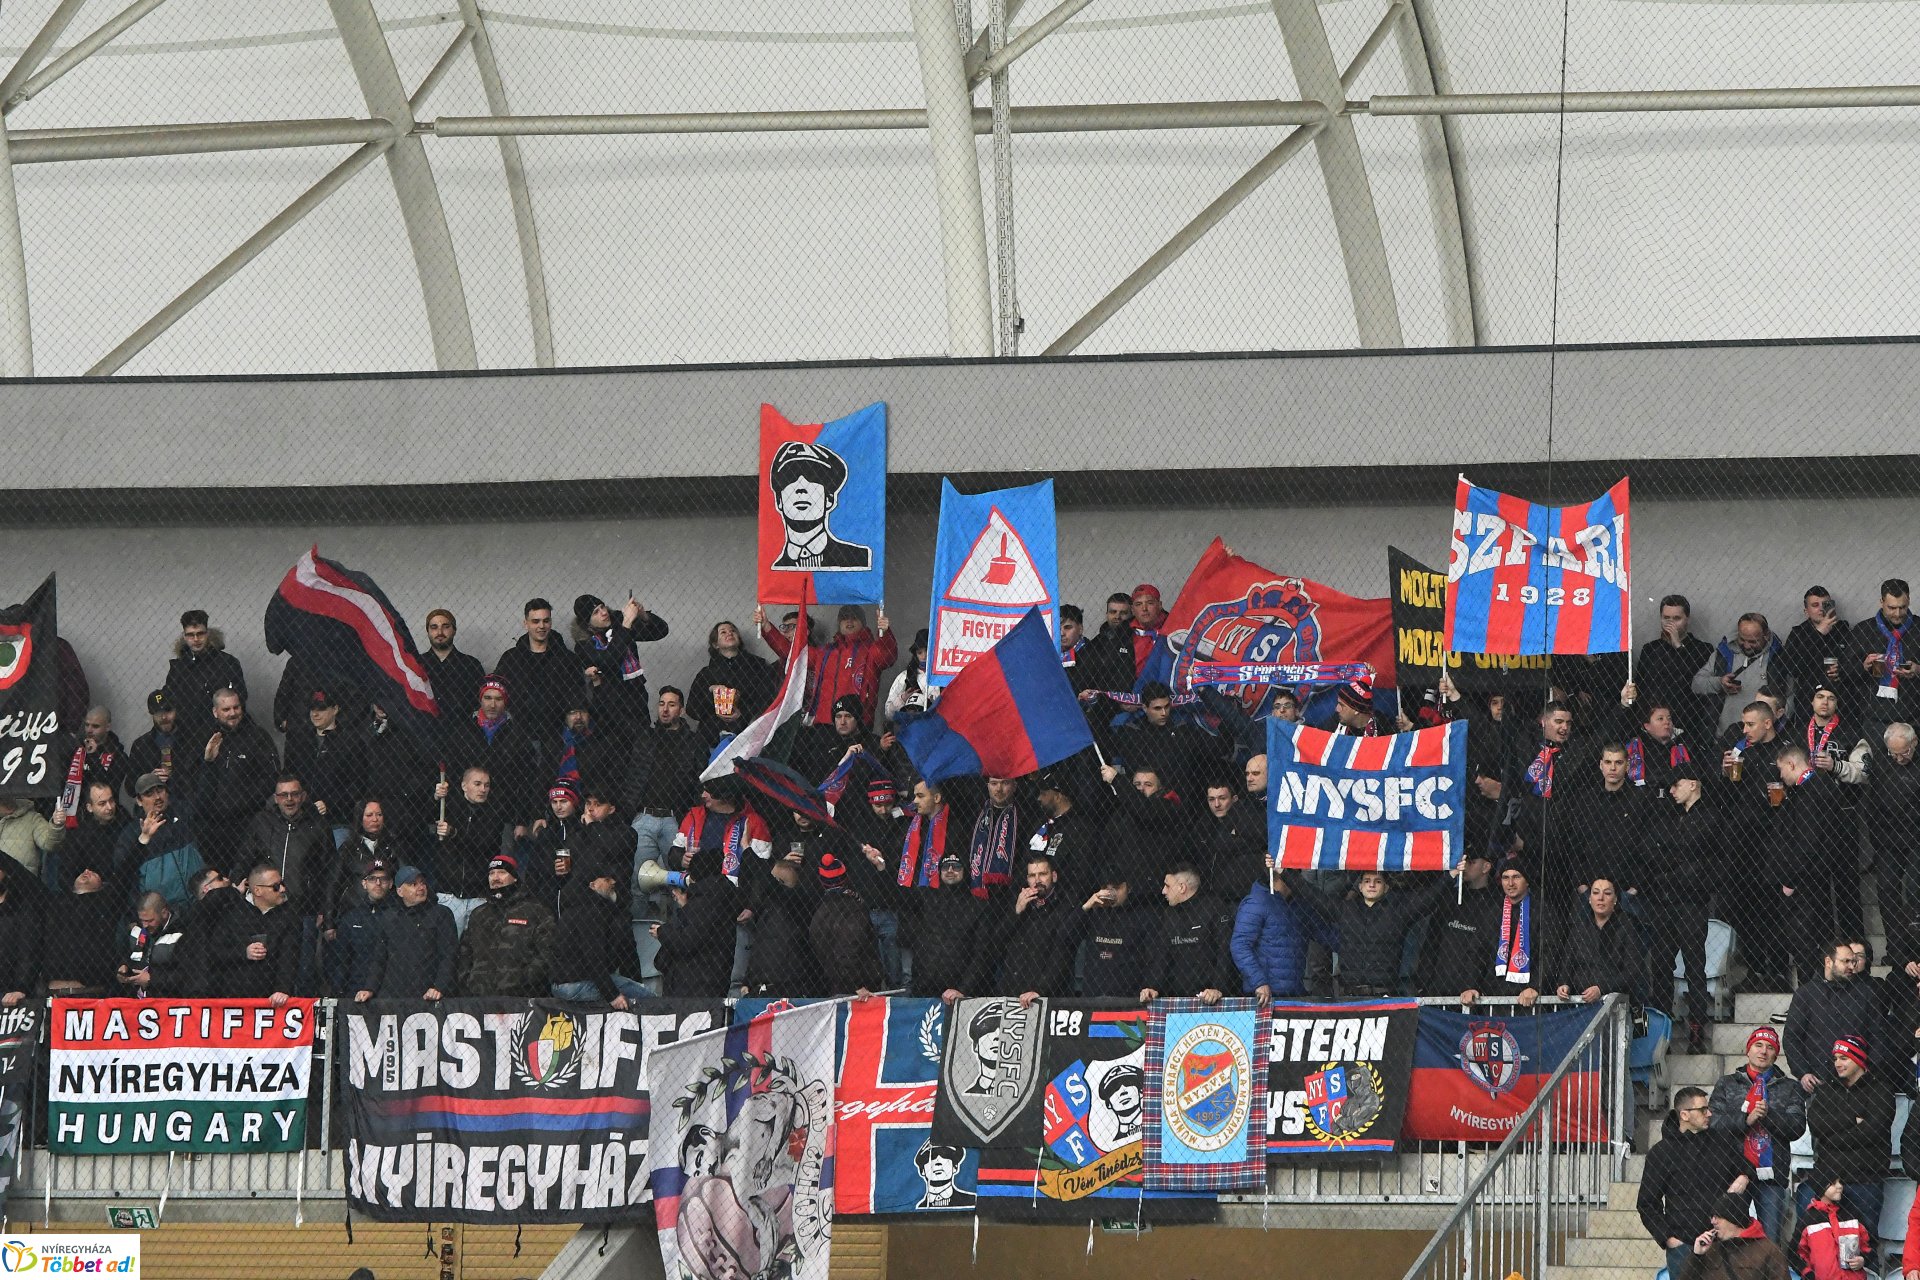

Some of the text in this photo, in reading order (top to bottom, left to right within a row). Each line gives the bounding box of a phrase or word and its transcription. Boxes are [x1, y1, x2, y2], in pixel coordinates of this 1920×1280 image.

[1448, 508, 1628, 592] SZPARI
[1496, 583, 1591, 606] 1928
[962, 619, 1018, 640] FIGYEL
[1251, 633, 1281, 662] S
[1277, 770, 1454, 822] NYSFC
[0, 1007, 36, 1035] iffs
[63, 1006, 305, 1042] MASTIFFS
[385, 1024, 396, 1084] 1995
[997, 1000, 1028, 1099] NYSFC
[1269, 1016, 1389, 1062] STERN
[1475, 1041, 1500, 1058] NY S
[57, 1057, 301, 1095] NYÍREGYHÁZA
[1308, 1072, 1342, 1101] NY S
[1491, 1063, 1500, 1079] C
[1065, 1072, 1088, 1107] S
[56, 1109, 297, 1144] HUNGARY
[807, 1087, 828, 1133] OLD
[1318, 1105, 1329, 1126] F
[1065, 1129, 1085, 1165] F
[1063, 1176, 1097, 1195] Vén
